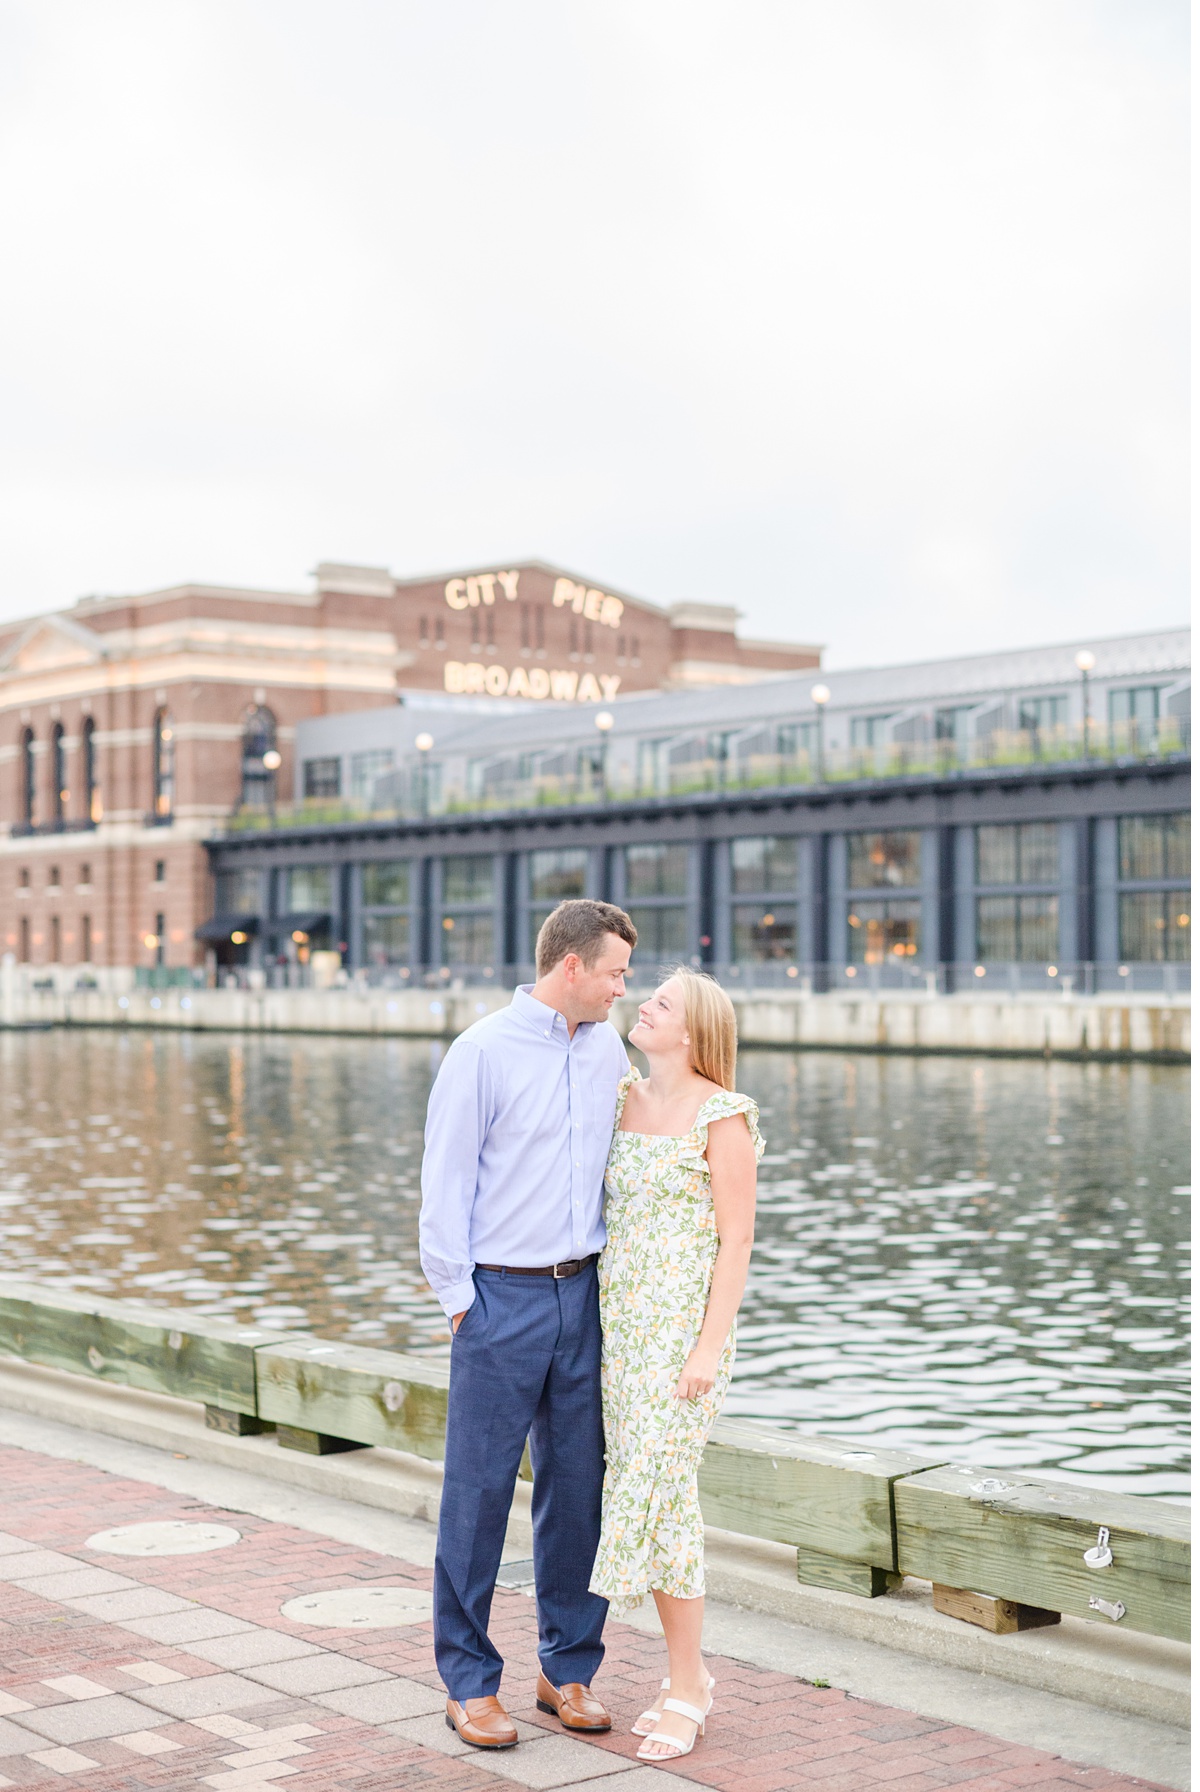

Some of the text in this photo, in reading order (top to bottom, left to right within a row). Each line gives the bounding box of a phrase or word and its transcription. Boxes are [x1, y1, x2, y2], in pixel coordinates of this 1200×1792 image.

[445, 569, 624, 629] CITY PIER
[444, 661, 621, 702] BROADWAY
